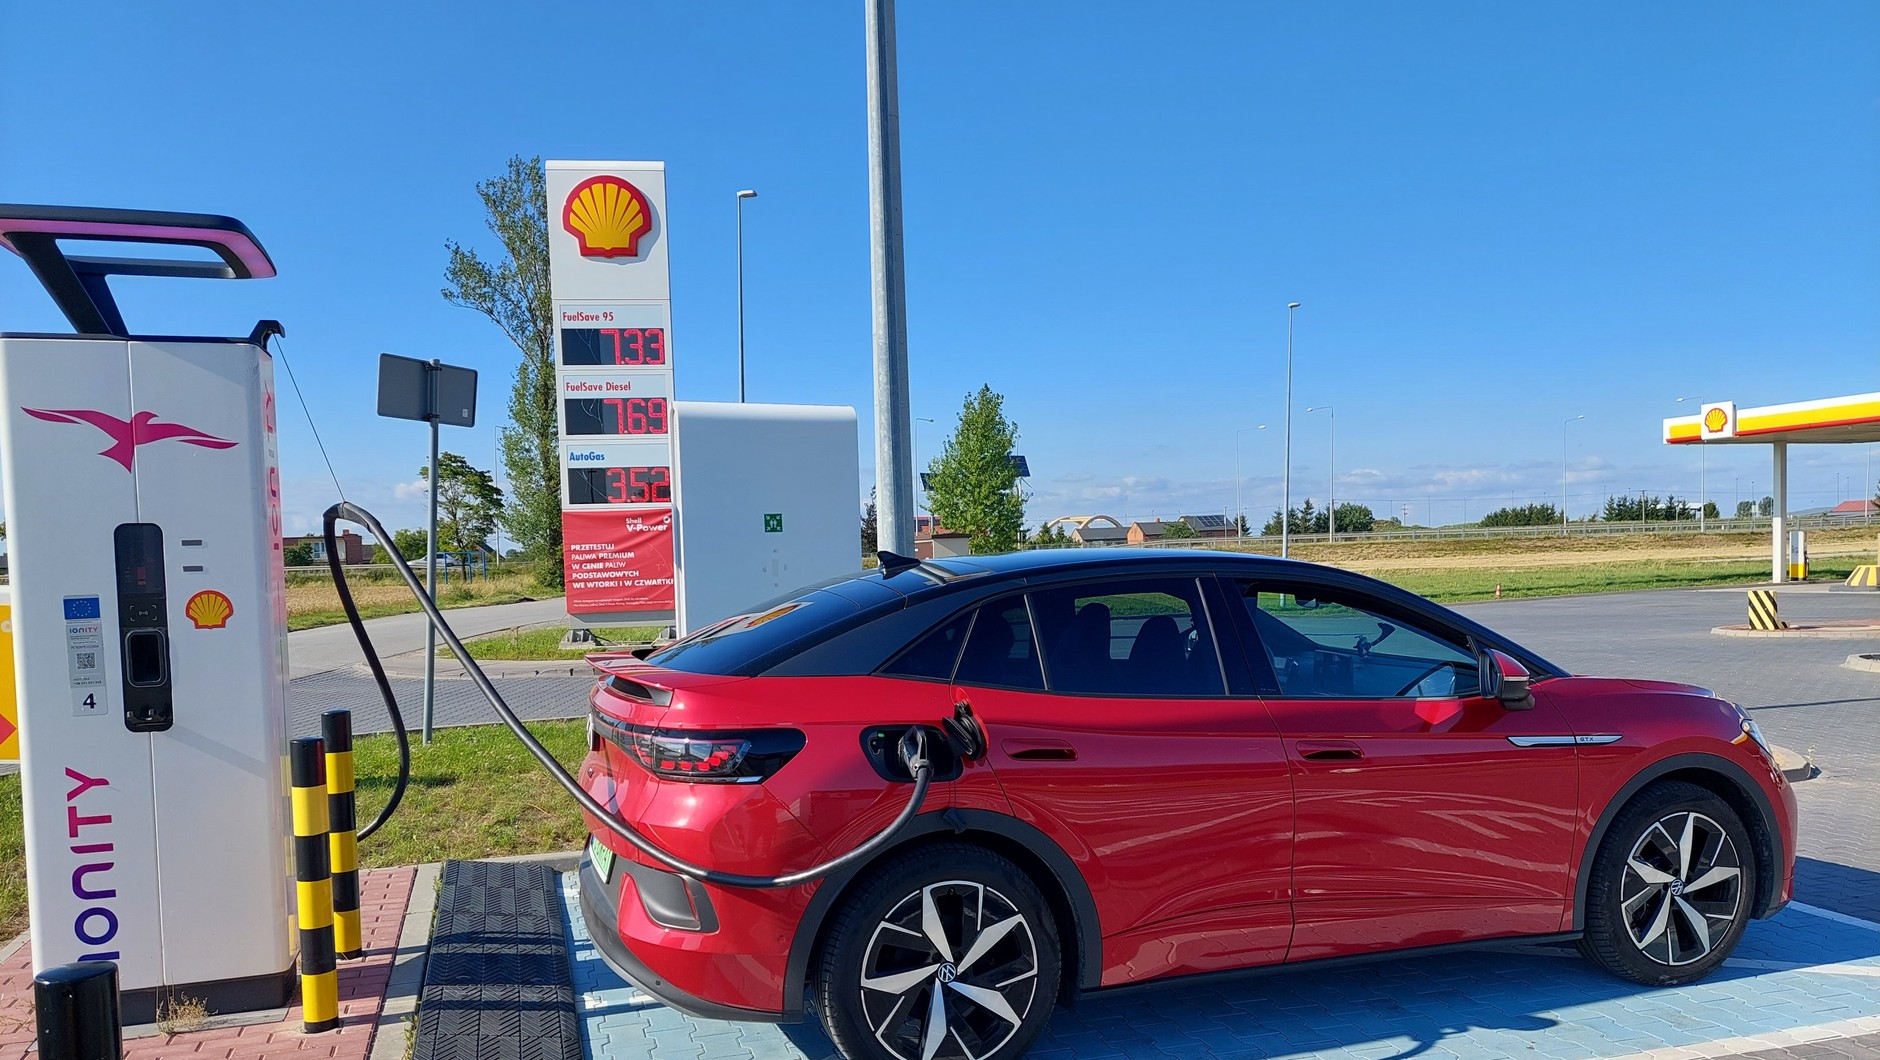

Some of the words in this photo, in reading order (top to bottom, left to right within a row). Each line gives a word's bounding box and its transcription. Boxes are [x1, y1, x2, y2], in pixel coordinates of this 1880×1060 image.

[562, 311, 600, 322] FuelSave
[602, 311, 614, 322] 95
[600, 328, 665, 365] 7.33
[565, 381, 603, 392] FuelSave
[605, 380, 631, 391] Diesel
[603, 398, 668, 435] 7.69
[569, 451, 605, 462] AutoGas
[606, 466, 671, 503] 3.52
[626, 524, 668, 532] V-Power
[572, 571, 639, 579] PODSTAWOWYCH
[69, 626, 98, 634] IONITY
[82, 692, 97, 710] 4
